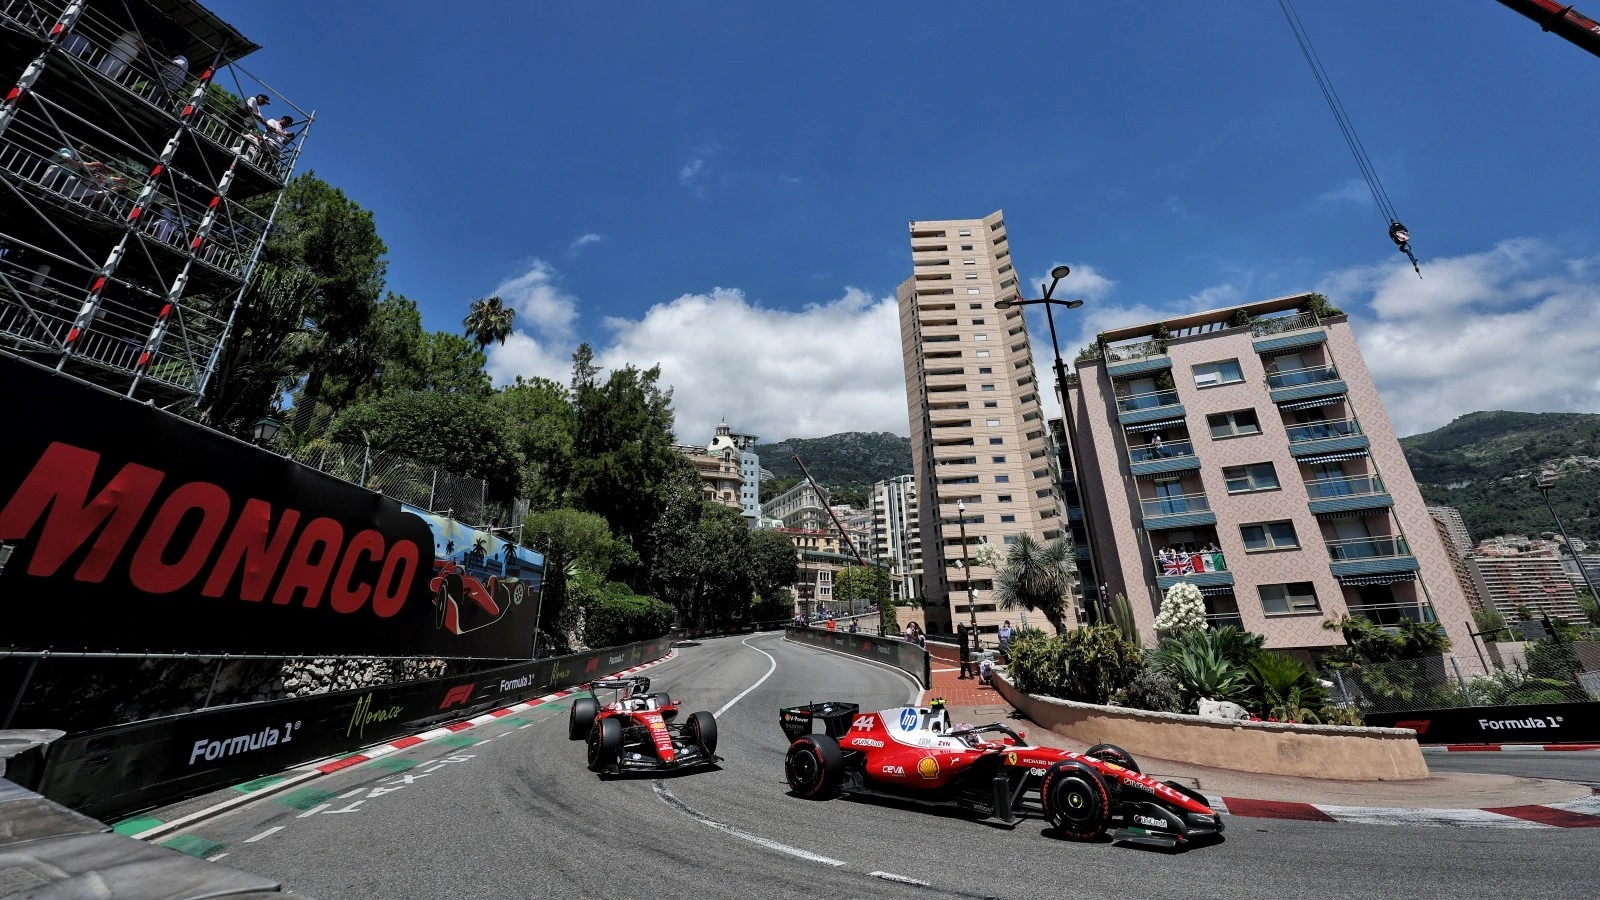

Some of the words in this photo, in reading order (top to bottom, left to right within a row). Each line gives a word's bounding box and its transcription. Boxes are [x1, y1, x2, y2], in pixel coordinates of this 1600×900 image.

[0, 441, 418, 617] MONACO
[499, 675, 527, 693] Formula
[439, 683, 479, 710] F1
[346, 692, 404, 738] Monaco
[852, 715, 875, 732] 44
[901, 709, 917, 731] hp
[1478, 717, 1547, 731] Formula
[188, 726, 280, 765] Formula
[882, 765, 905, 775] CEVA
